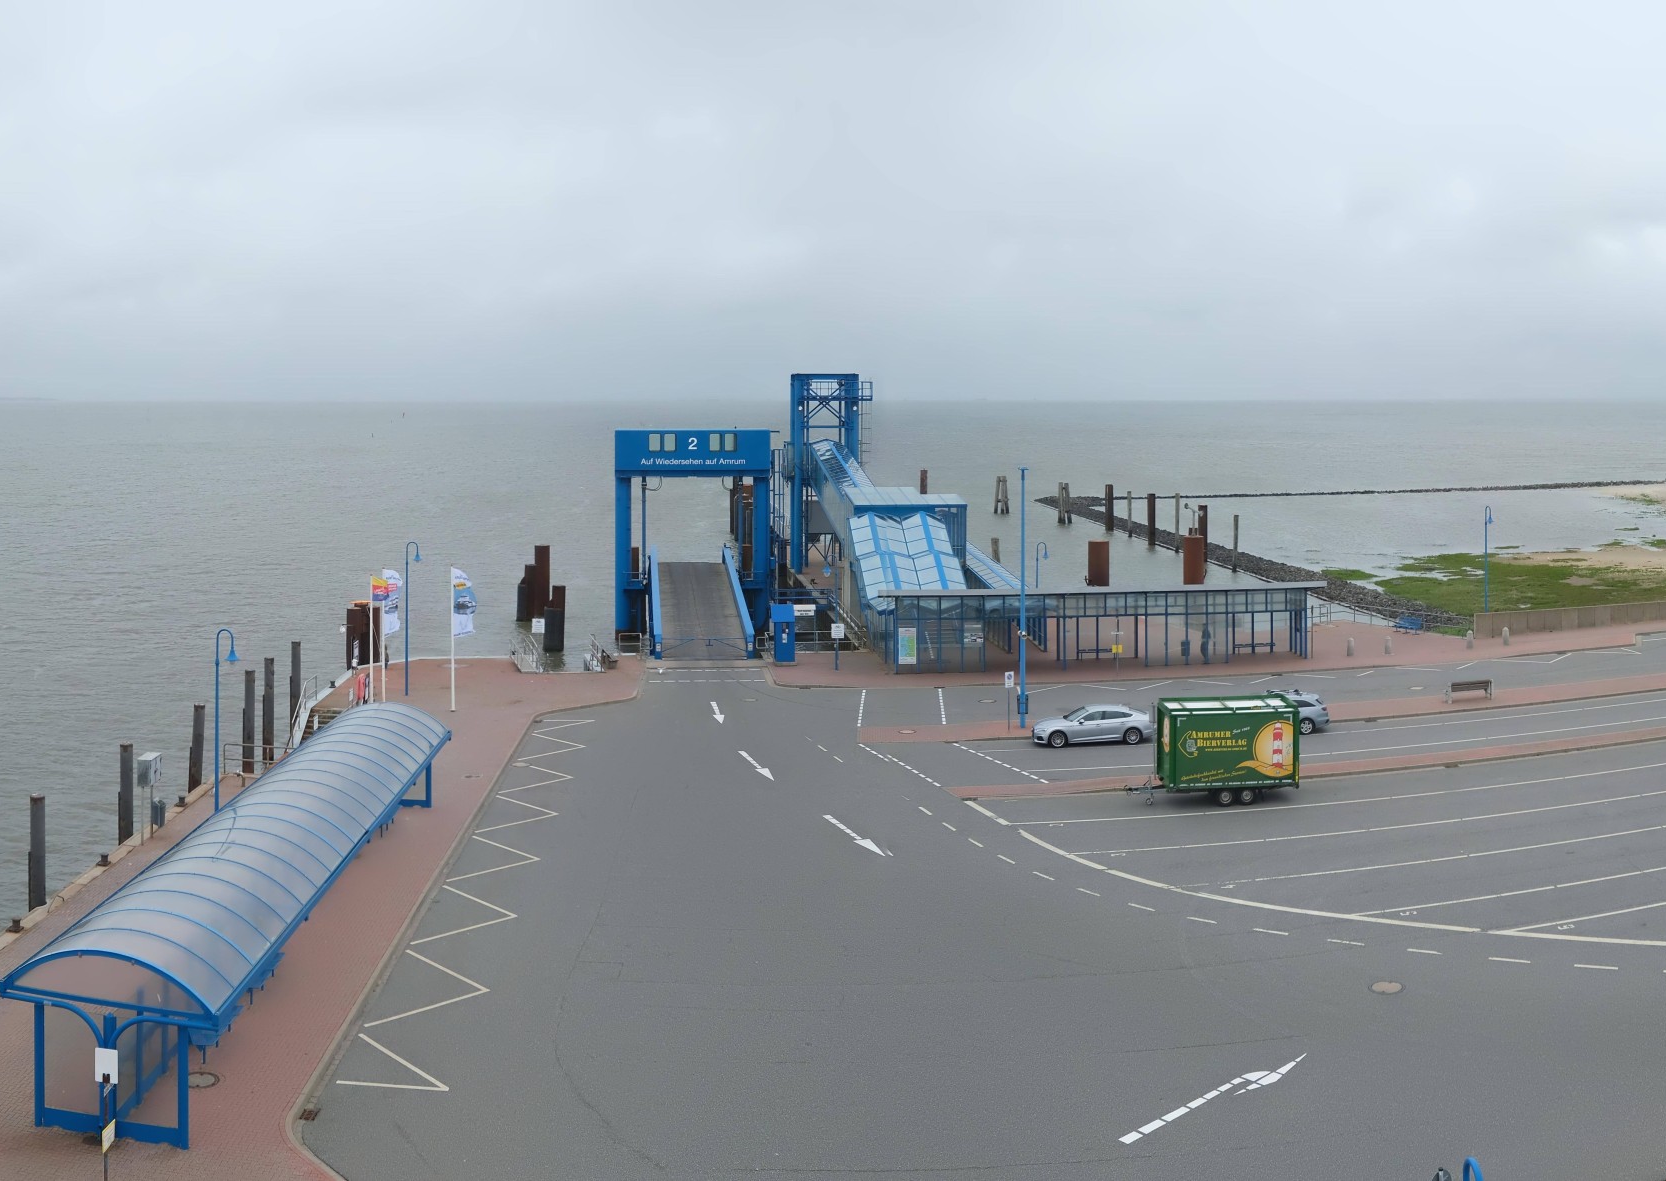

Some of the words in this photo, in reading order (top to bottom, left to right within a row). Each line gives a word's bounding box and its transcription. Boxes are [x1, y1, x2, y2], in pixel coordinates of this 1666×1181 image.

[688, 437, 697, 450] 2
[640, 457, 653, 465] Auf
[655, 457, 703, 465] Wiedersehen
[705, 457, 717, 465] auf
[719, 457, 746, 465] Amrum
[1190, 730, 1231, 739] AMRUMER
[1197, 739, 1247, 747] BIERVERLAG
